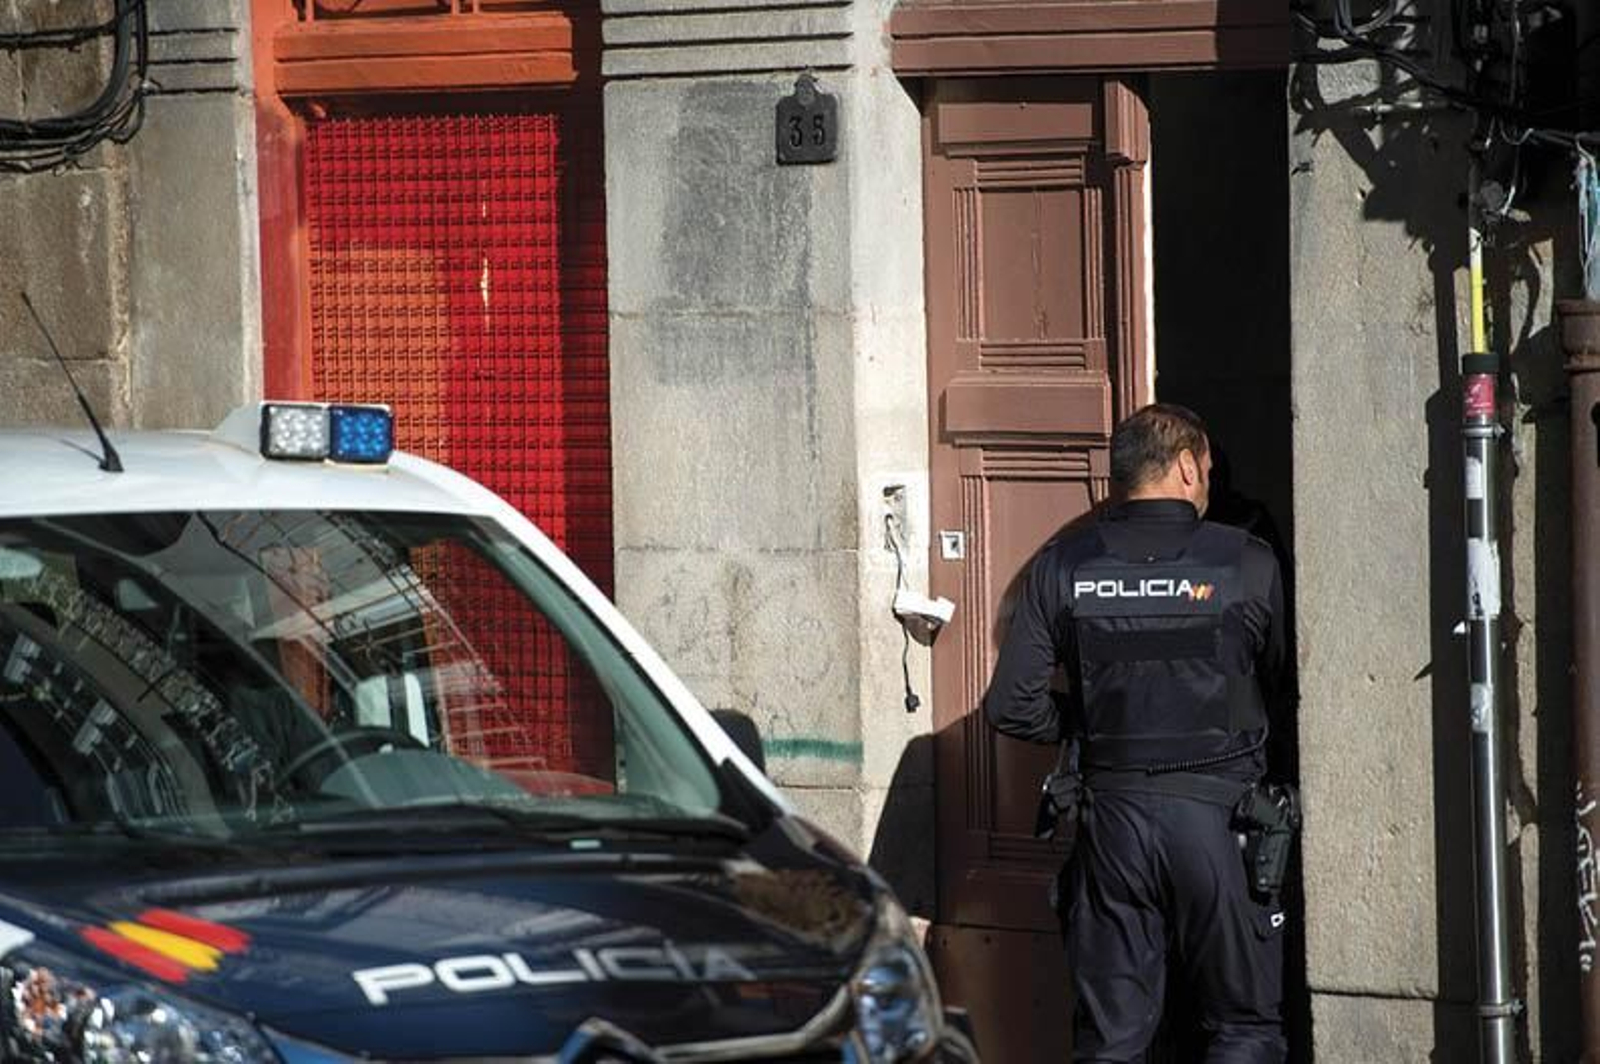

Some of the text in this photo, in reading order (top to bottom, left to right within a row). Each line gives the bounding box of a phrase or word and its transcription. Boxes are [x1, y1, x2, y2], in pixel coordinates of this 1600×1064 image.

[789, 114, 825, 148] 35
[1074, 579, 1195, 599] POLICIA
[353, 940, 757, 1006] POLICIA
